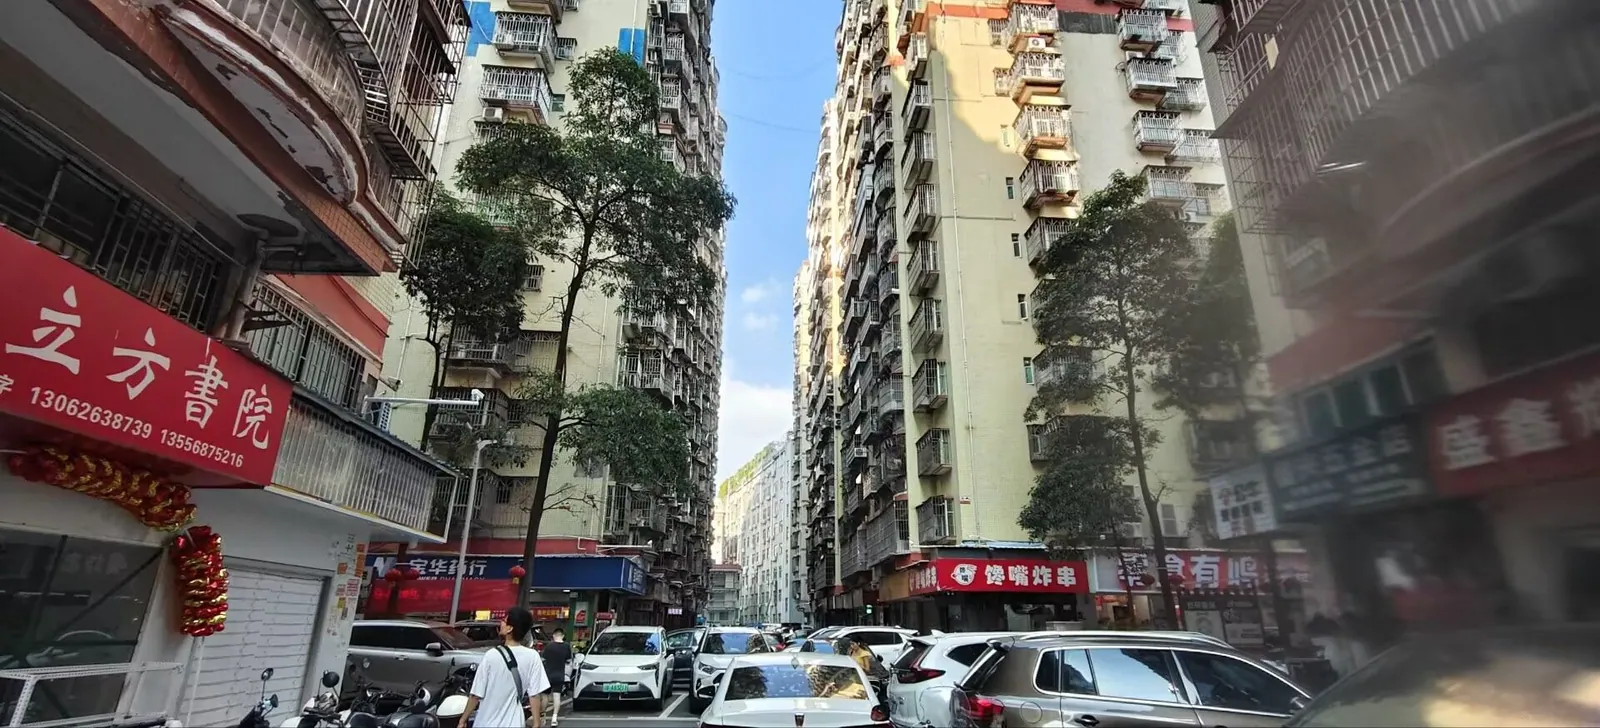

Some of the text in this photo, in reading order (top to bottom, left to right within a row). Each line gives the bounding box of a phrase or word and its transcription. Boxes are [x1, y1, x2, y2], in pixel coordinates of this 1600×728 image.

[5, 285, 274, 450] 立方書院
[31, 387, 152, 439] 13062638739
[160, 429, 244, 468] 13556875216
[984, 564, 1077, 587] 馋嘴炸串
